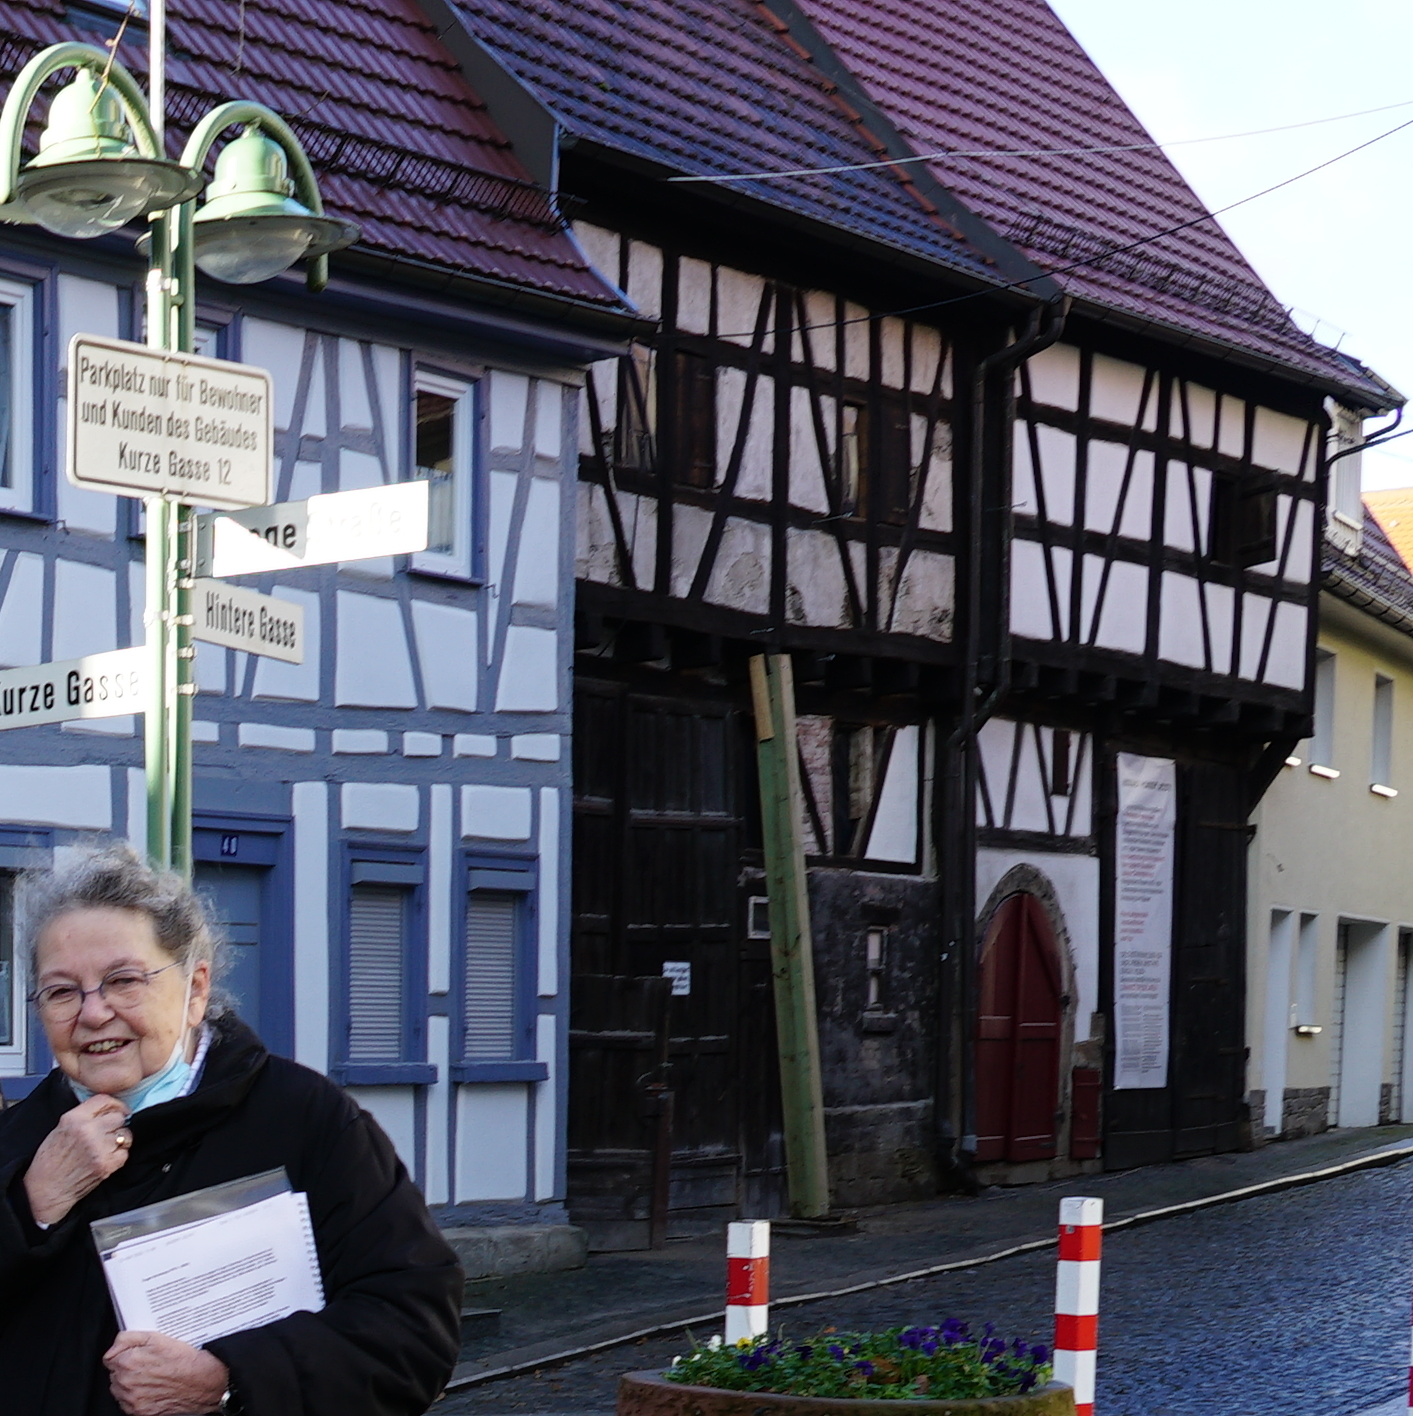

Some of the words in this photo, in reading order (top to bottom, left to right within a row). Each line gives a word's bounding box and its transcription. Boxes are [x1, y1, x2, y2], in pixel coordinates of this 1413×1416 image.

[80, 356, 145, 393] Parkplatz
[149, 373, 171, 399] nur
[175, 373, 196, 403] für
[199, 378, 264, 416] Bewohner
[81, 399, 106, 426] und
[111, 400, 163, 437] Kunden
[166, 411, 190, 440] des
[195, 416, 258, 452] Gebäudes
[118, 441, 161, 474] Kurze
[168, 450, 211, 483] Gasse
[217, 458, 233, 486] 12
[205, 591, 255, 640] Hintere
[259, 605, 297, 649] Gasse
[67, 669, 140, 706] Gasse
